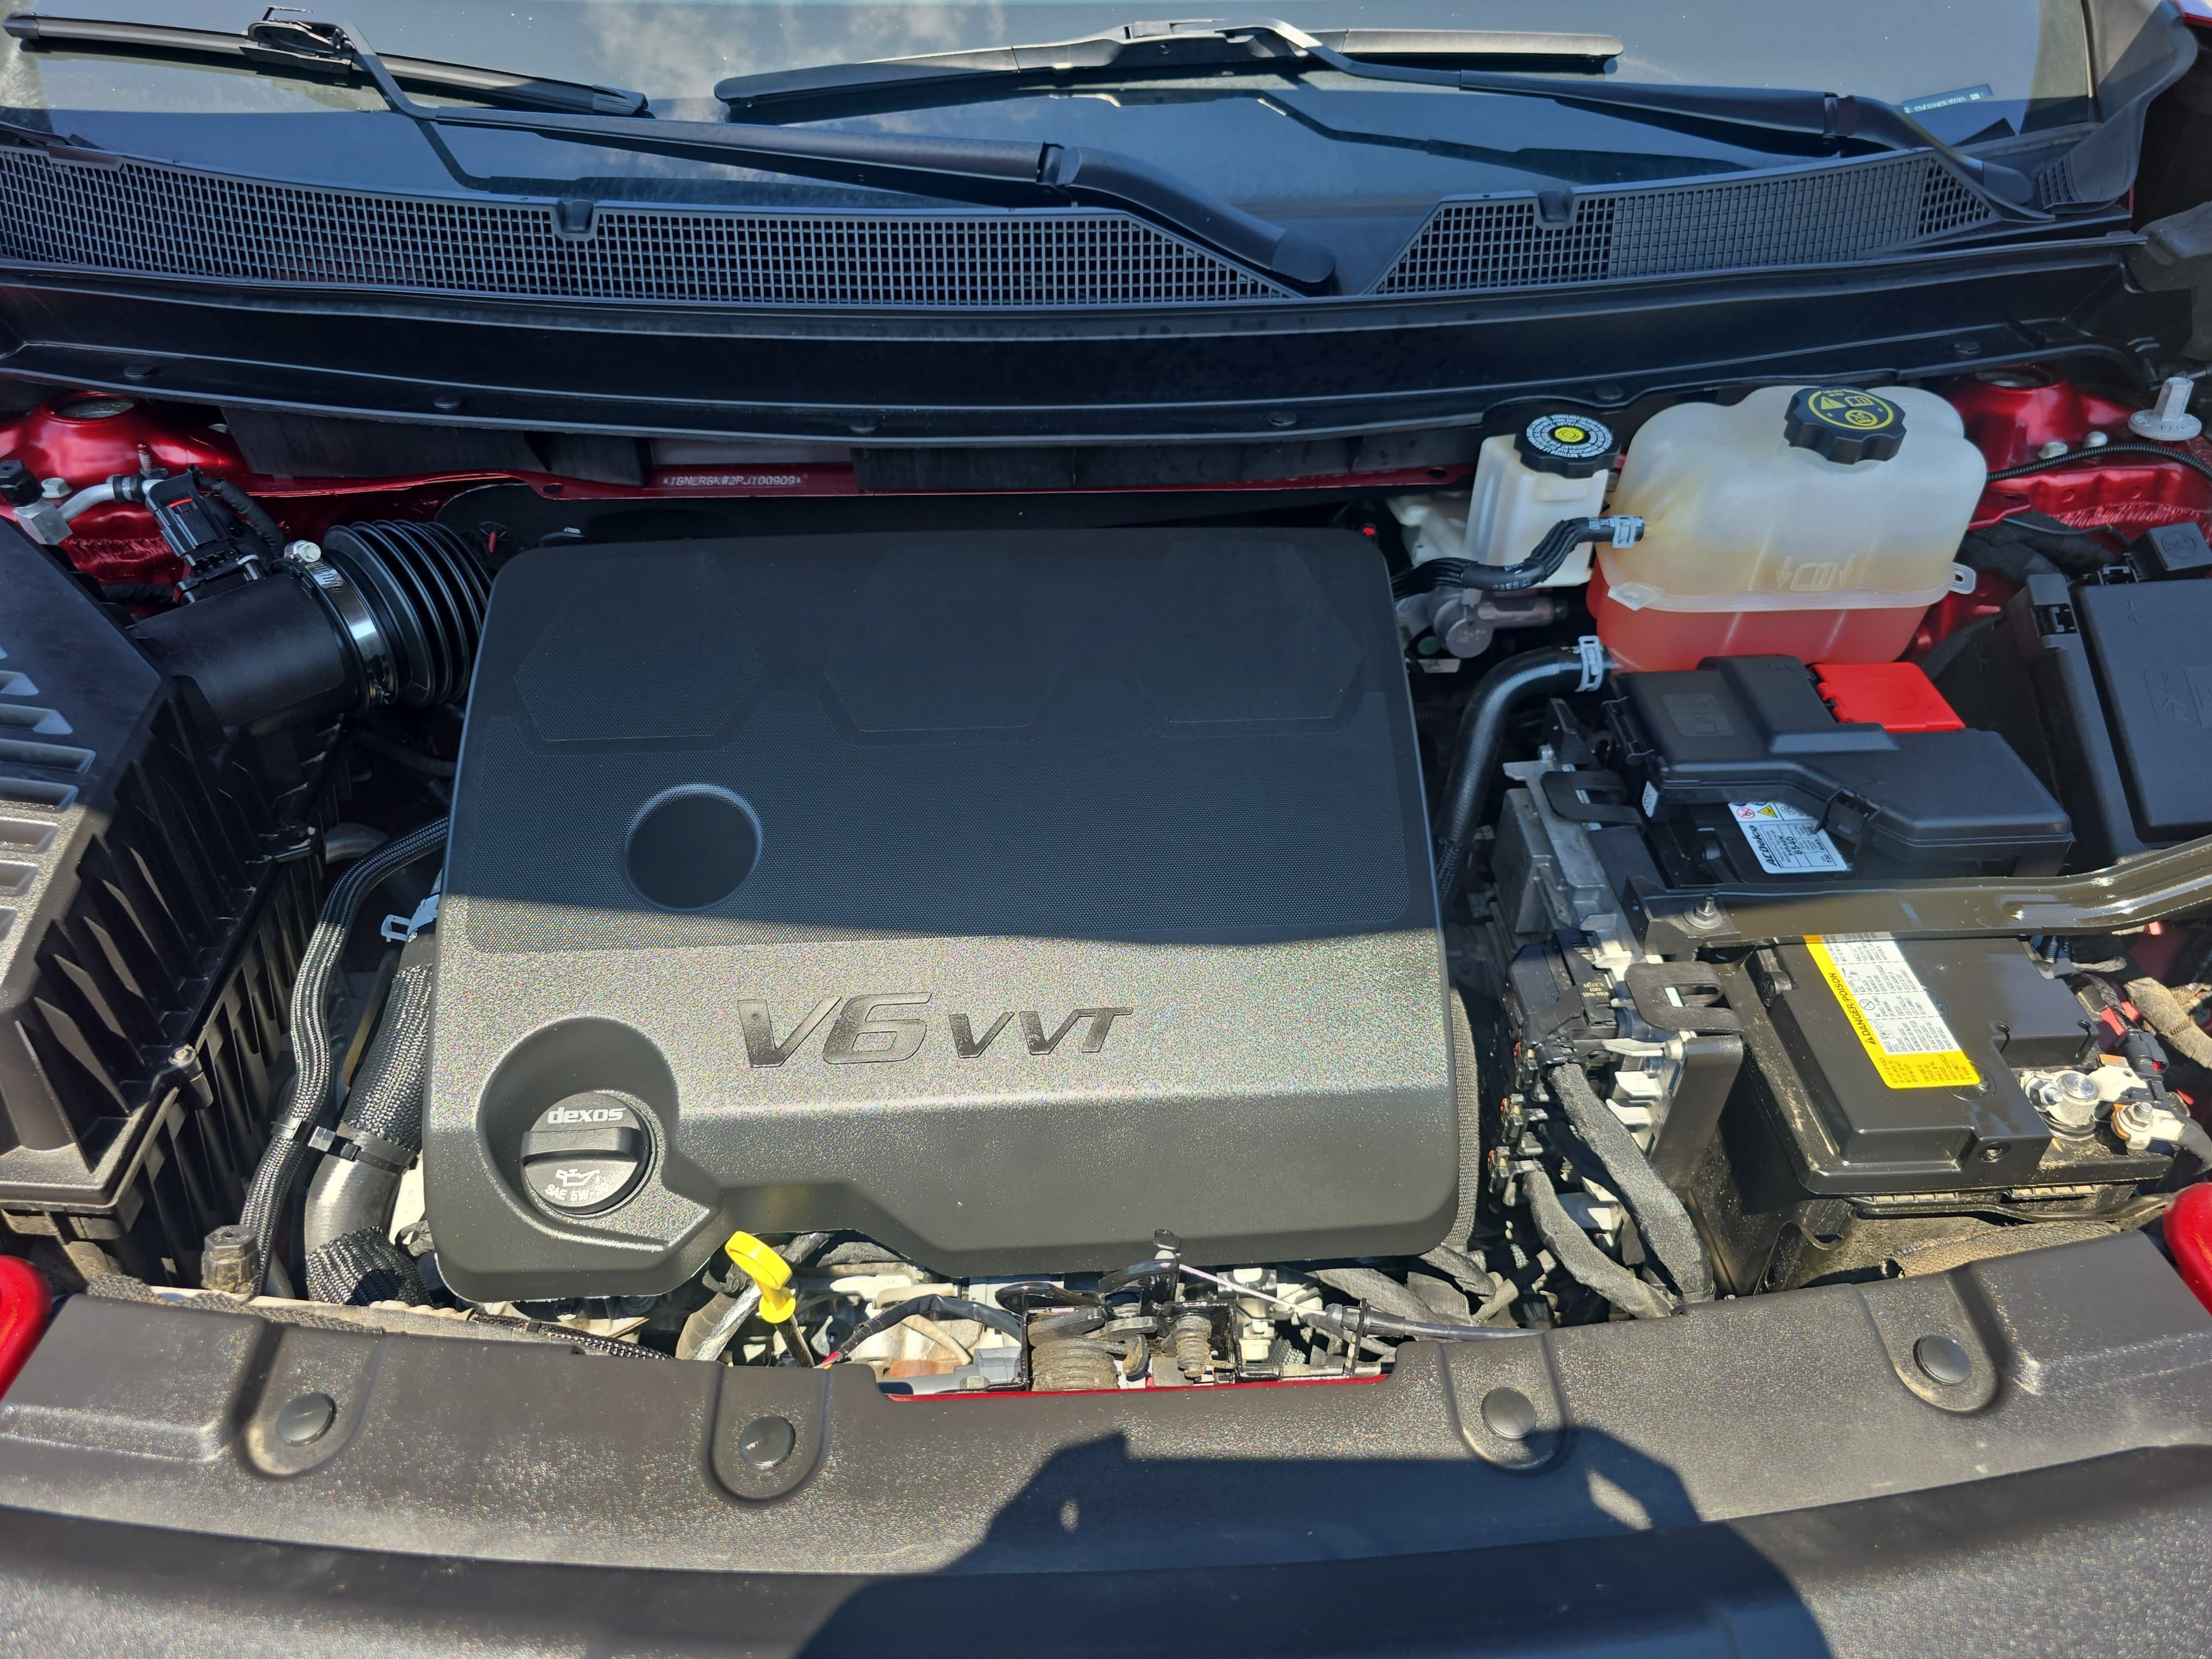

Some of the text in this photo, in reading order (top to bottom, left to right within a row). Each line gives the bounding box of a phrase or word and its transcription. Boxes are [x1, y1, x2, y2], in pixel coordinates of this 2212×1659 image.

[1748, 825, 1778, 867] ACDelco
[737, 992, 1134, 1069] V6 VVT
[547, 1107, 627, 1124] dexos
[545, 1181, 609, 1201] SAE 5W-30
